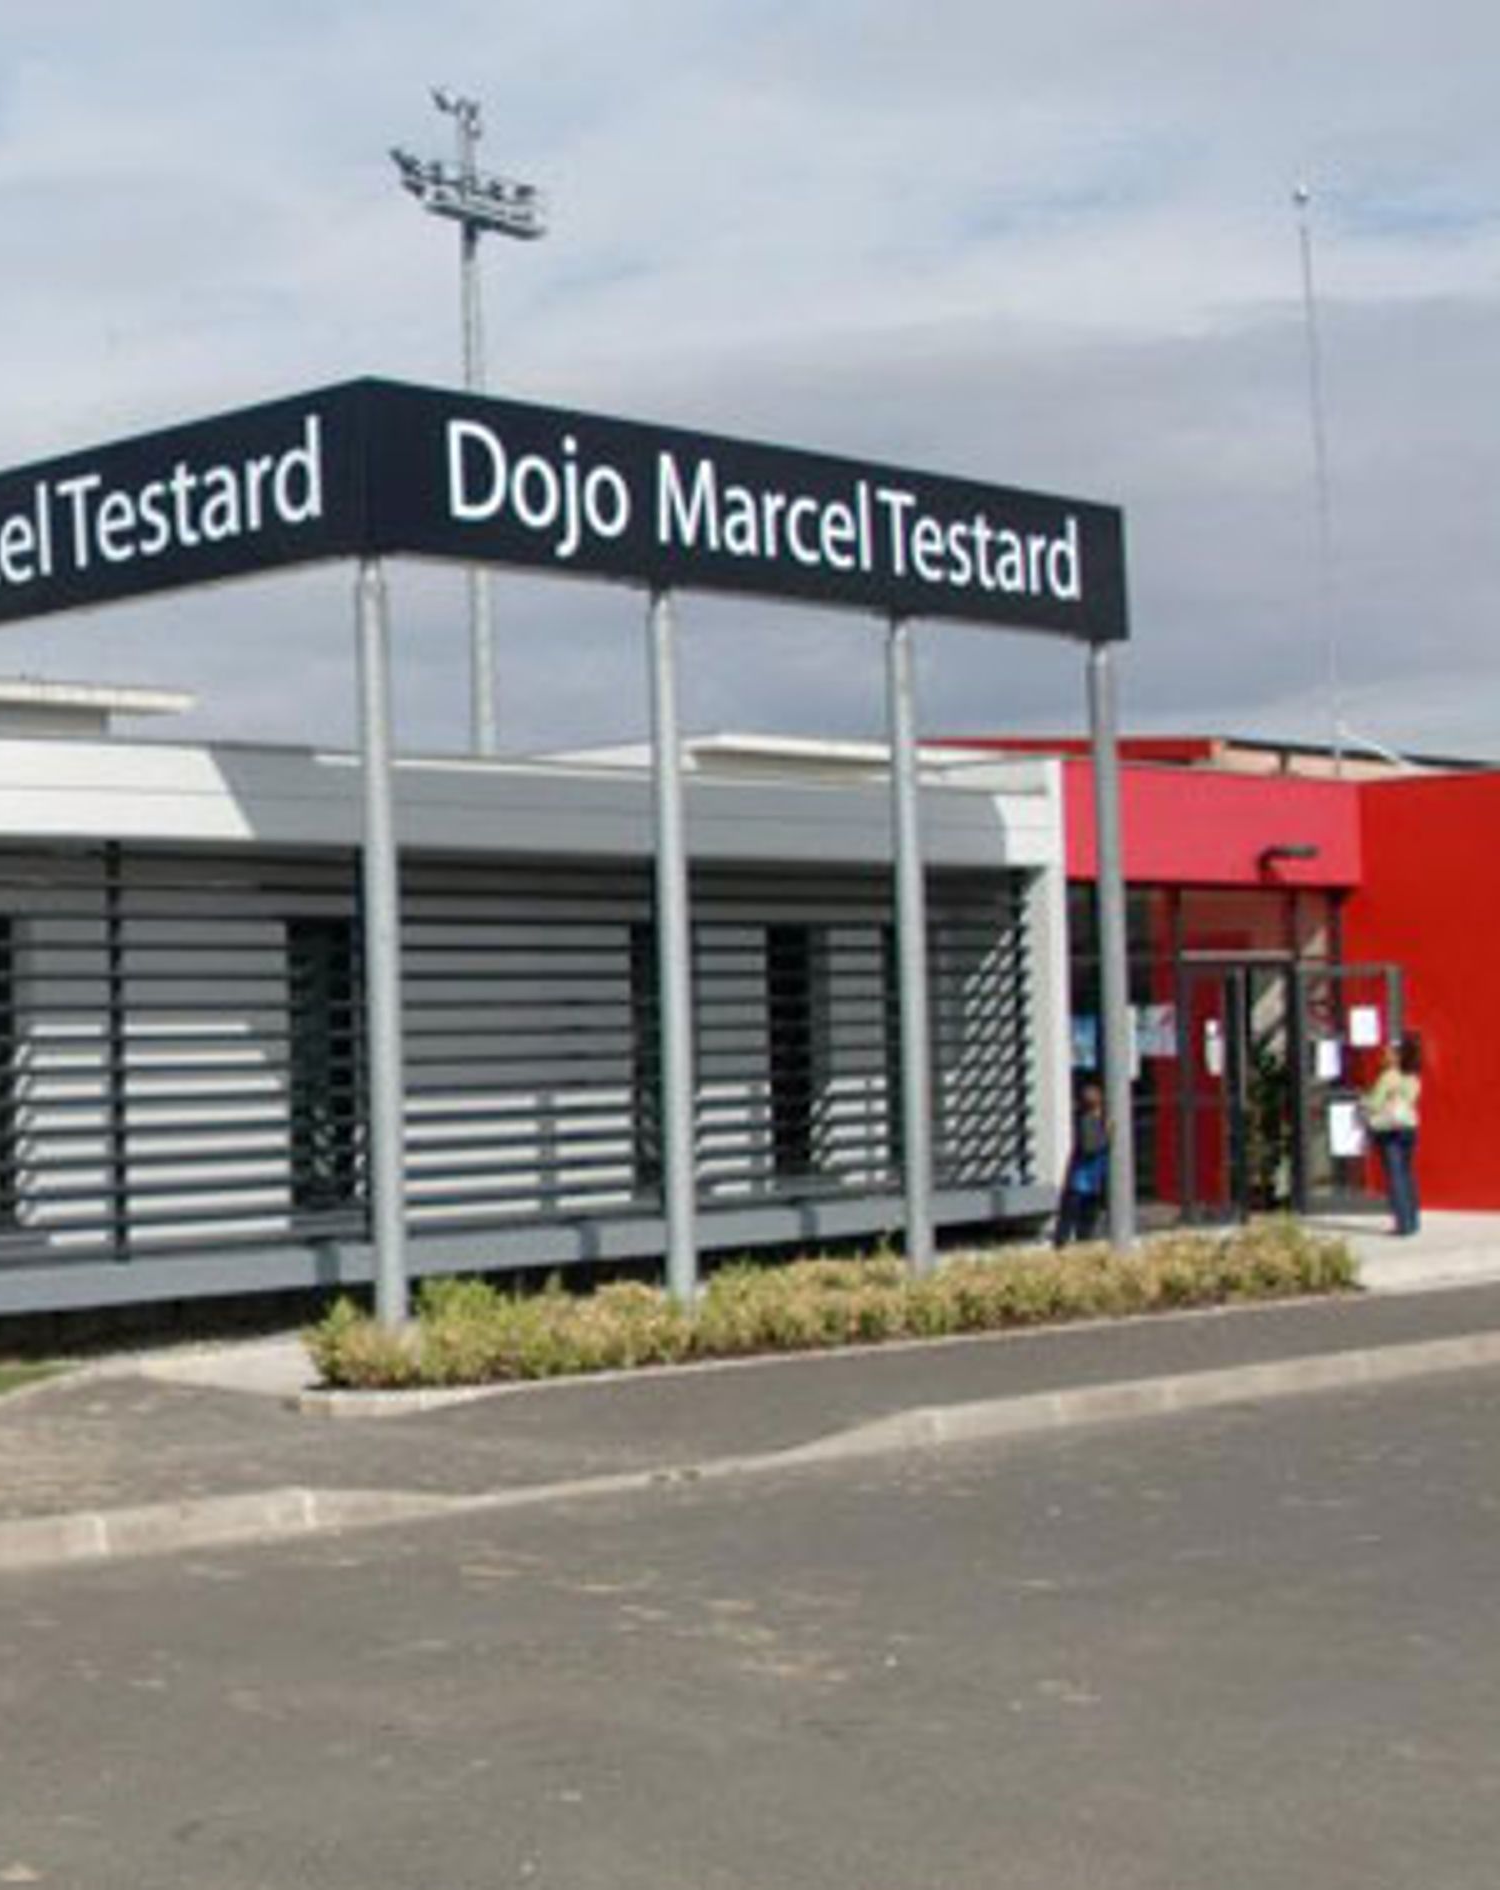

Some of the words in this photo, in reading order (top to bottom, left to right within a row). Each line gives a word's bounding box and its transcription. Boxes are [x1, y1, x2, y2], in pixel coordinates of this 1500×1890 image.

[54, 413, 323, 569] Testard
[446, 418, 631, 559] Dojo
[657, 450, 873, 572] Marcel
[874, 487, 1082, 601] Testard
